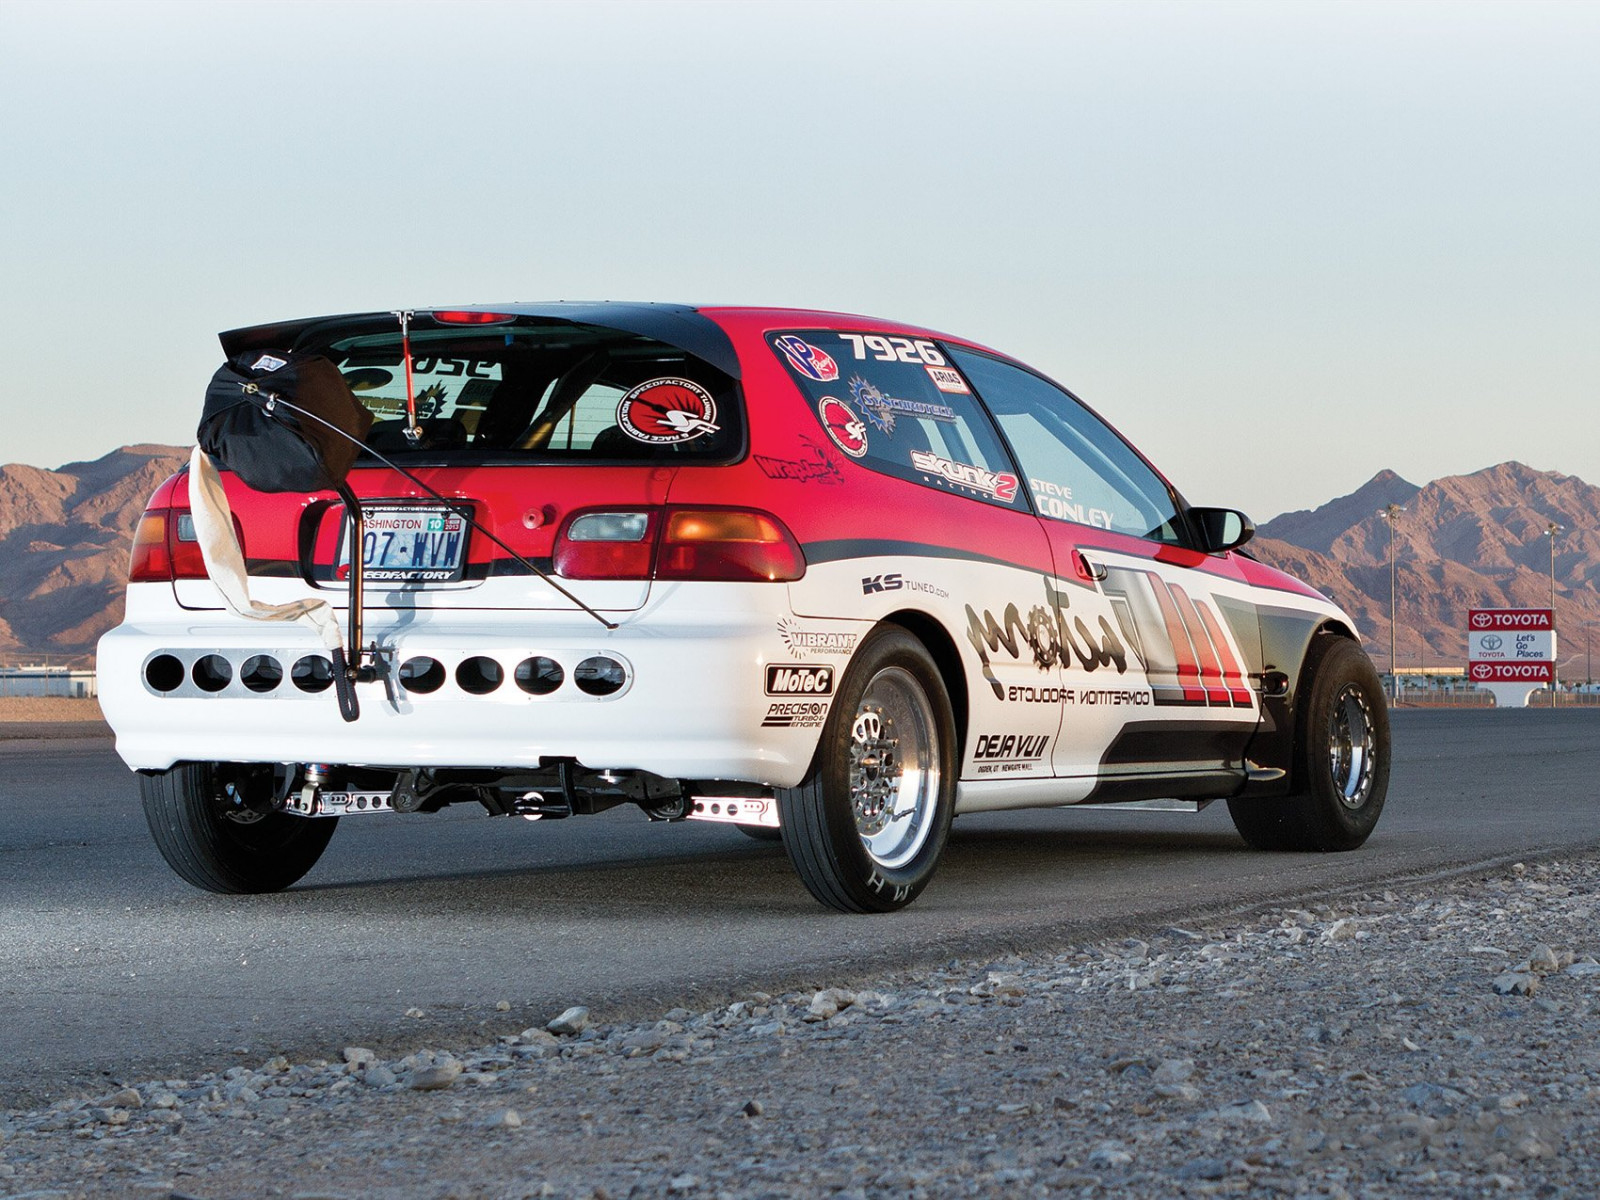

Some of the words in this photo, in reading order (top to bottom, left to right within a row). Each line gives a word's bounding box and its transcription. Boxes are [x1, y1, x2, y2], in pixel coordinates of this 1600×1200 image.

[838, 334, 946, 366] 7926
[933, 371, 961, 384] ARIAS
[630, 379, 702, 400] SPEEDFACTORY
[700, 394, 712, 421] TUNING
[621, 400, 651, 441] FABRICATION
[651, 434, 680, 442] RACE
[924, 476, 989, 498] RACING
[1029, 478, 1073, 500] STEVE
[1034, 494, 1114, 530] CONLEY
[363, 519, 422, 530] ASHINGTON
[429, 520, 442, 529] 10
[861, 573, 903, 595] KS
[904, 580, 950, 599] TUNED.COM
[1494, 614, 1549, 625] TOYOTA
[791, 632, 857, 649] VIBRANT
[1516, 634, 1536, 642] Let's
[1516, 642, 1528, 650] Go
[1516, 650, 1544, 658] Places
[1494, 666, 1549, 677] TOYOTA
[974, 735, 1016, 758] DEJA
